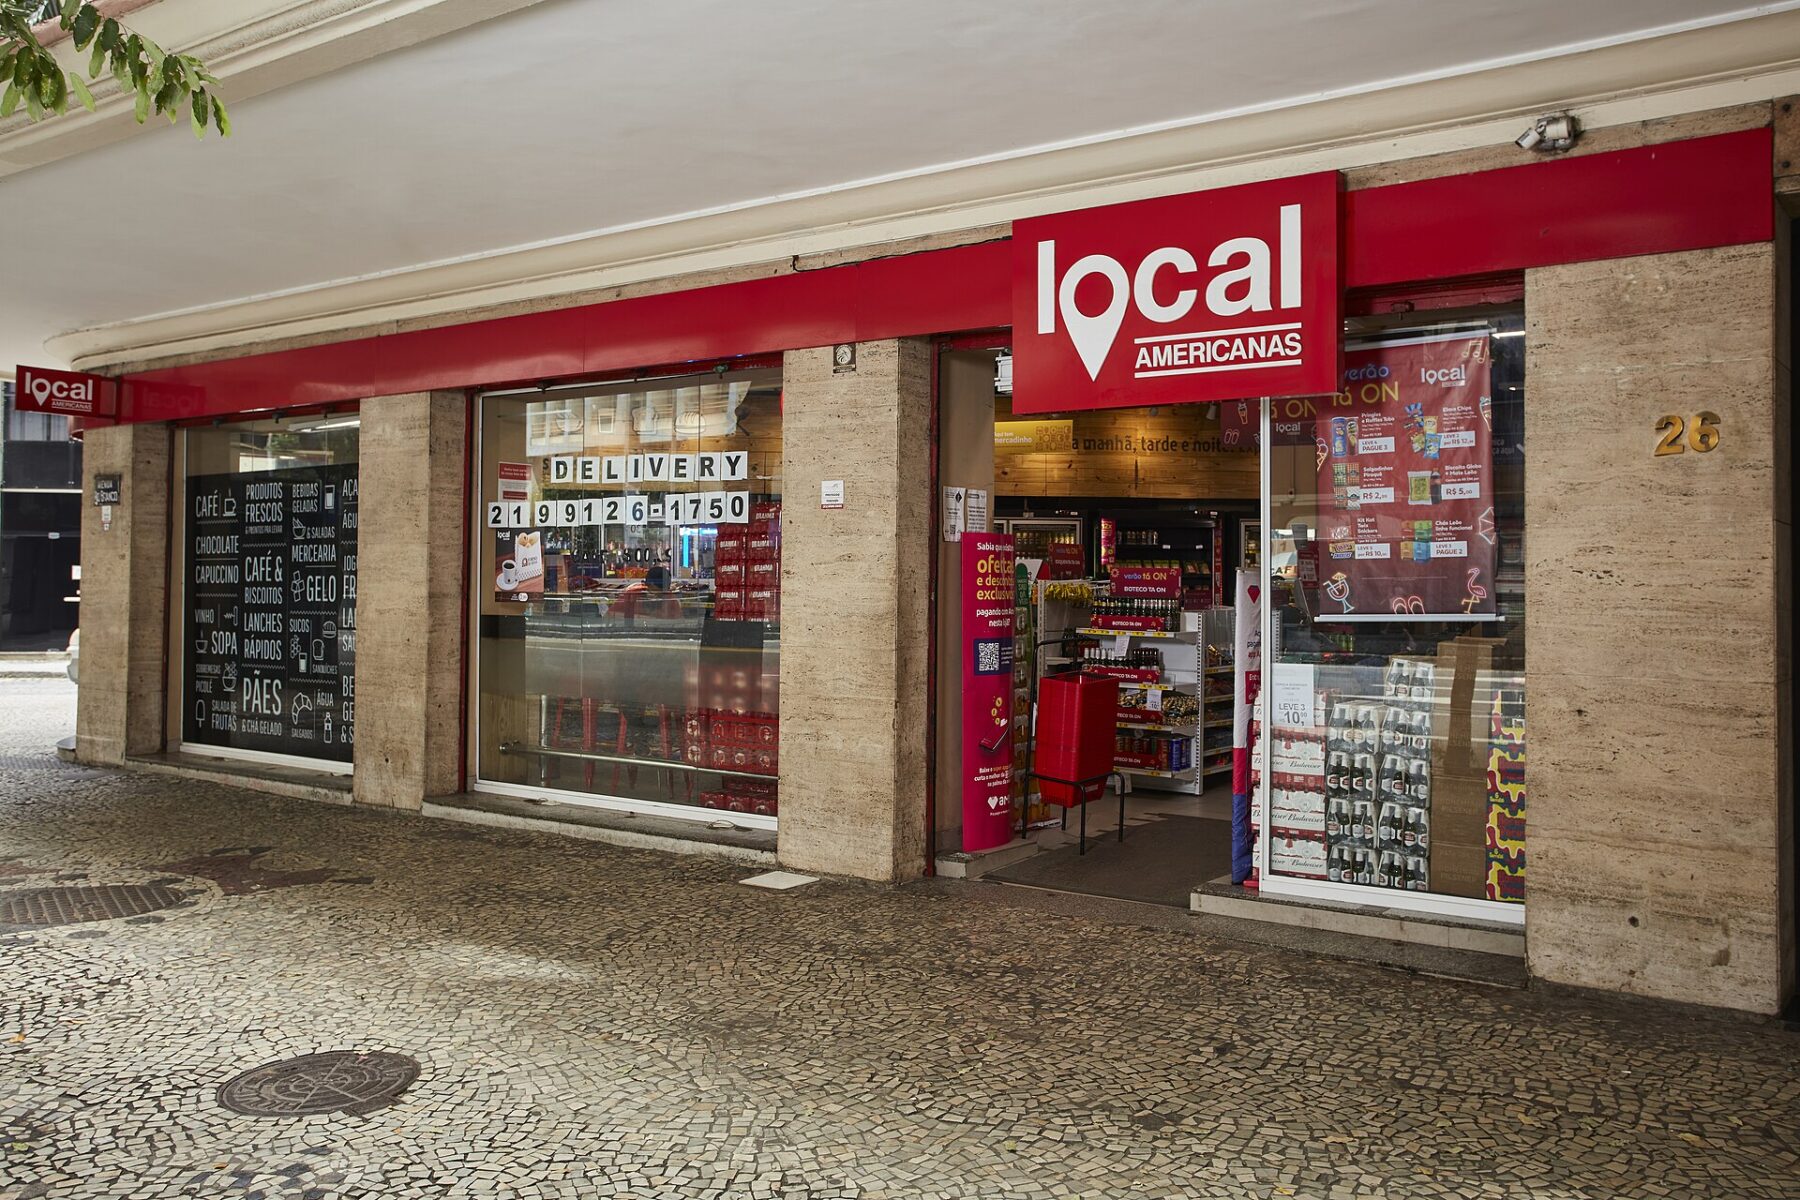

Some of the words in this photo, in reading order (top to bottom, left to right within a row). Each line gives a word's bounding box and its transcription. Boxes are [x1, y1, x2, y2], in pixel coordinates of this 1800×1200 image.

[1037, 203, 1302, 382] local
[1135, 333, 1302, 369] AMERICANAS
[1421, 364, 1465, 384] local
[25, 372, 93, 406] local
[1361, 381, 1398, 404] ON
[1276, 422, 1300, 433] local
[1654, 410, 1721, 457] 26
[1141, 436, 1177, 451] tarde
[1181, 440, 1189, 451] e
[555, 455, 741, 480] DELIVERY
[245, 482, 283, 500] PRODUTOS
[292, 483, 318, 498] BEBIDAS
[195, 489, 218, 517] CAFÉ
[292, 499, 318, 513] GELADAS
[245, 502, 283, 523] FRESCOS
[491, 505, 521, 525] 21
[311, 526, 335, 538] SALADAS
[195, 536, 239, 554] CHOCOLATE
[292, 544, 337, 562] MERCEARIA
[977, 542, 994, 551] Sabia
[195, 565, 239, 584] CAPUCCINO
[245, 550, 271, 582] CAFÉ
[275, 556, 283, 582] &
[1153, 572, 1167, 580] ON
[244, 587, 283, 604] BISCOITOS
[306, 575, 336, 602] GELO
[195, 609, 214, 623] VINHO
[244, 613, 283, 633] LANCHES
[289, 618, 310, 632] SUCOS
[211, 631, 238, 655] SOPA
[244, 634, 282, 660] RÁPIDOS
[243, 669, 282, 715] PÃES
[316, 688, 334, 707] ÁGUA
[211, 699, 229, 712] SALADA
[230, 701, 237, 713] DE
[1301, 703, 1306, 711] 3
[211, 713, 237, 731] FRUTAS
[247, 717, 259, 733] CHÁ
[260, 720, 282, 736] GELADO
[1290, 760, 1322, 768] Budweiser
[1288, 813, 1324, 823] Budweiser
[1292, 859, 1323, 868] Budweiser
